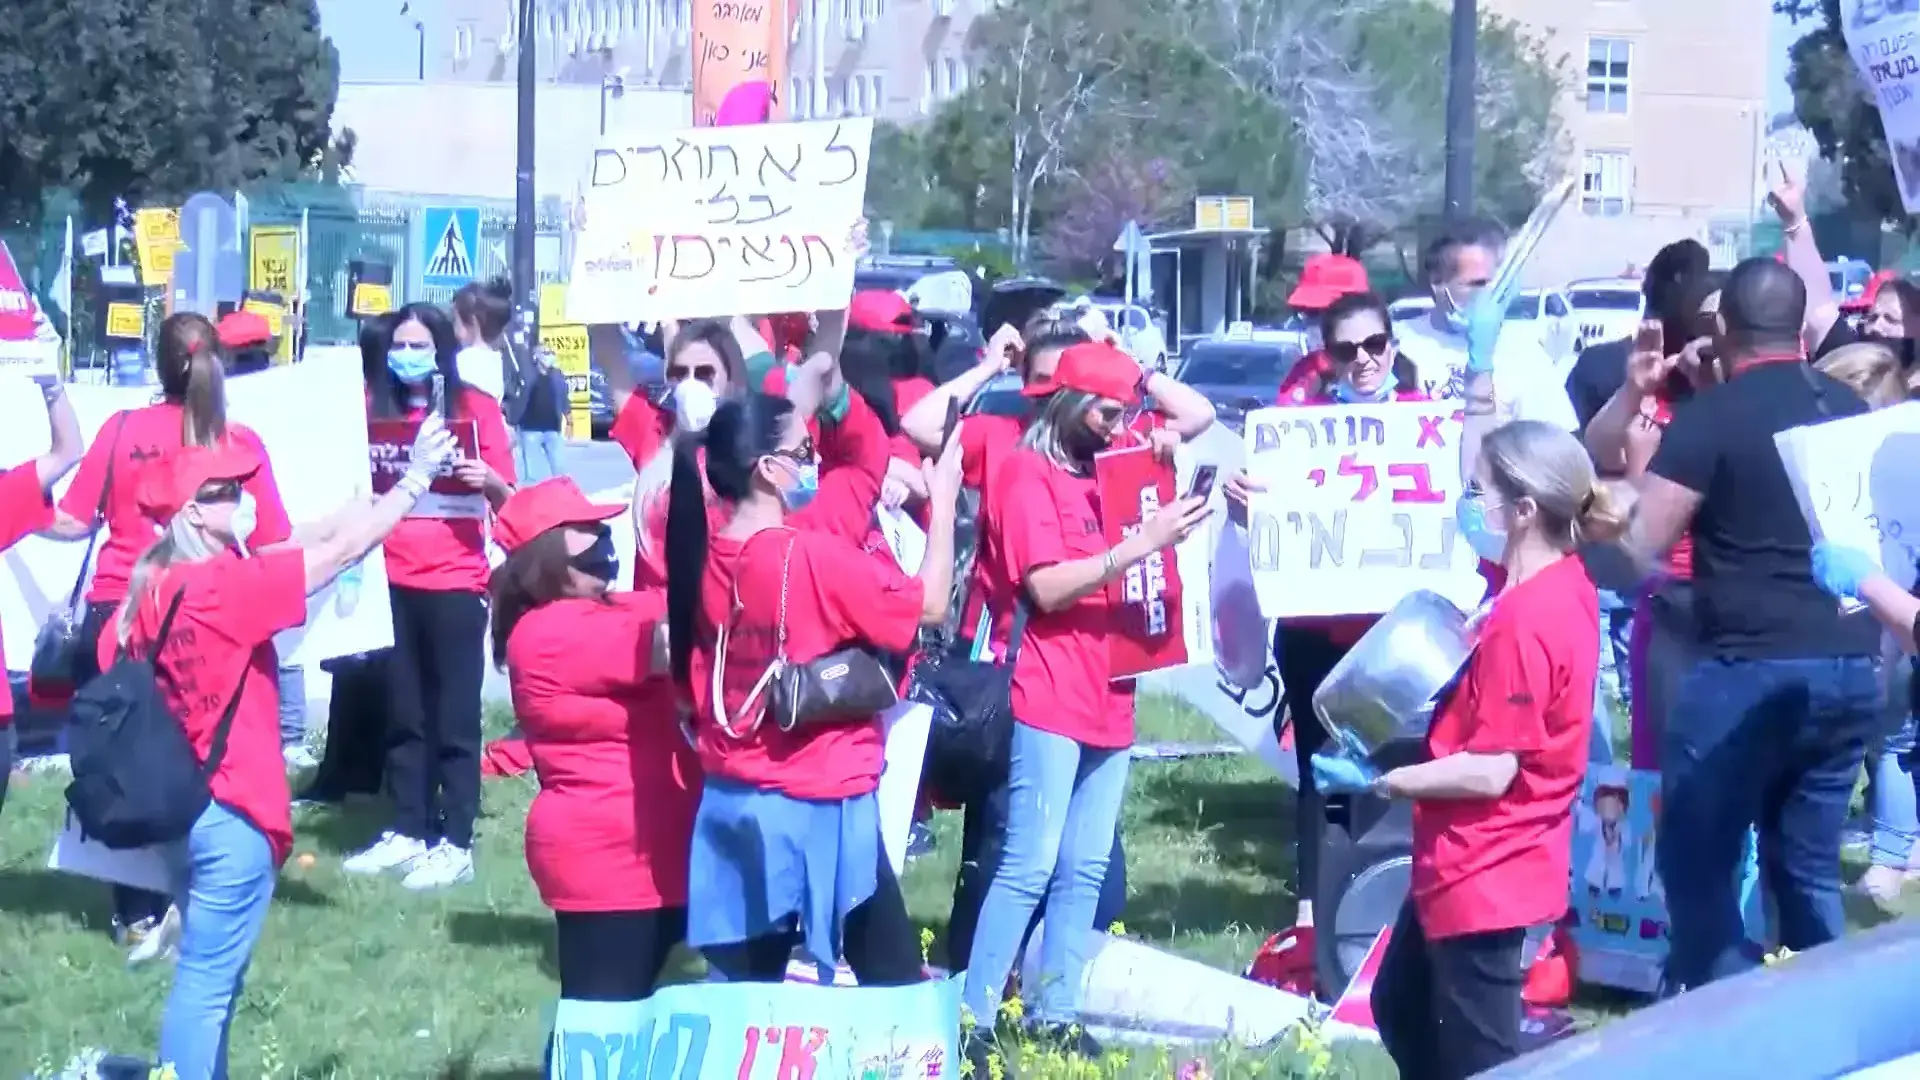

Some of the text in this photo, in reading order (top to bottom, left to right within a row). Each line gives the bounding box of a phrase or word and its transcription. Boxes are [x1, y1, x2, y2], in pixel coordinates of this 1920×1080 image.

[741, 49, 770, 72] אני
[592, 124, 858, 188] לא חוזרים
[695, 182, 793, 225] בלי
[1253, 415, 1385, 454] חוזרים
[1307, 451, 1446, 504] בלי
